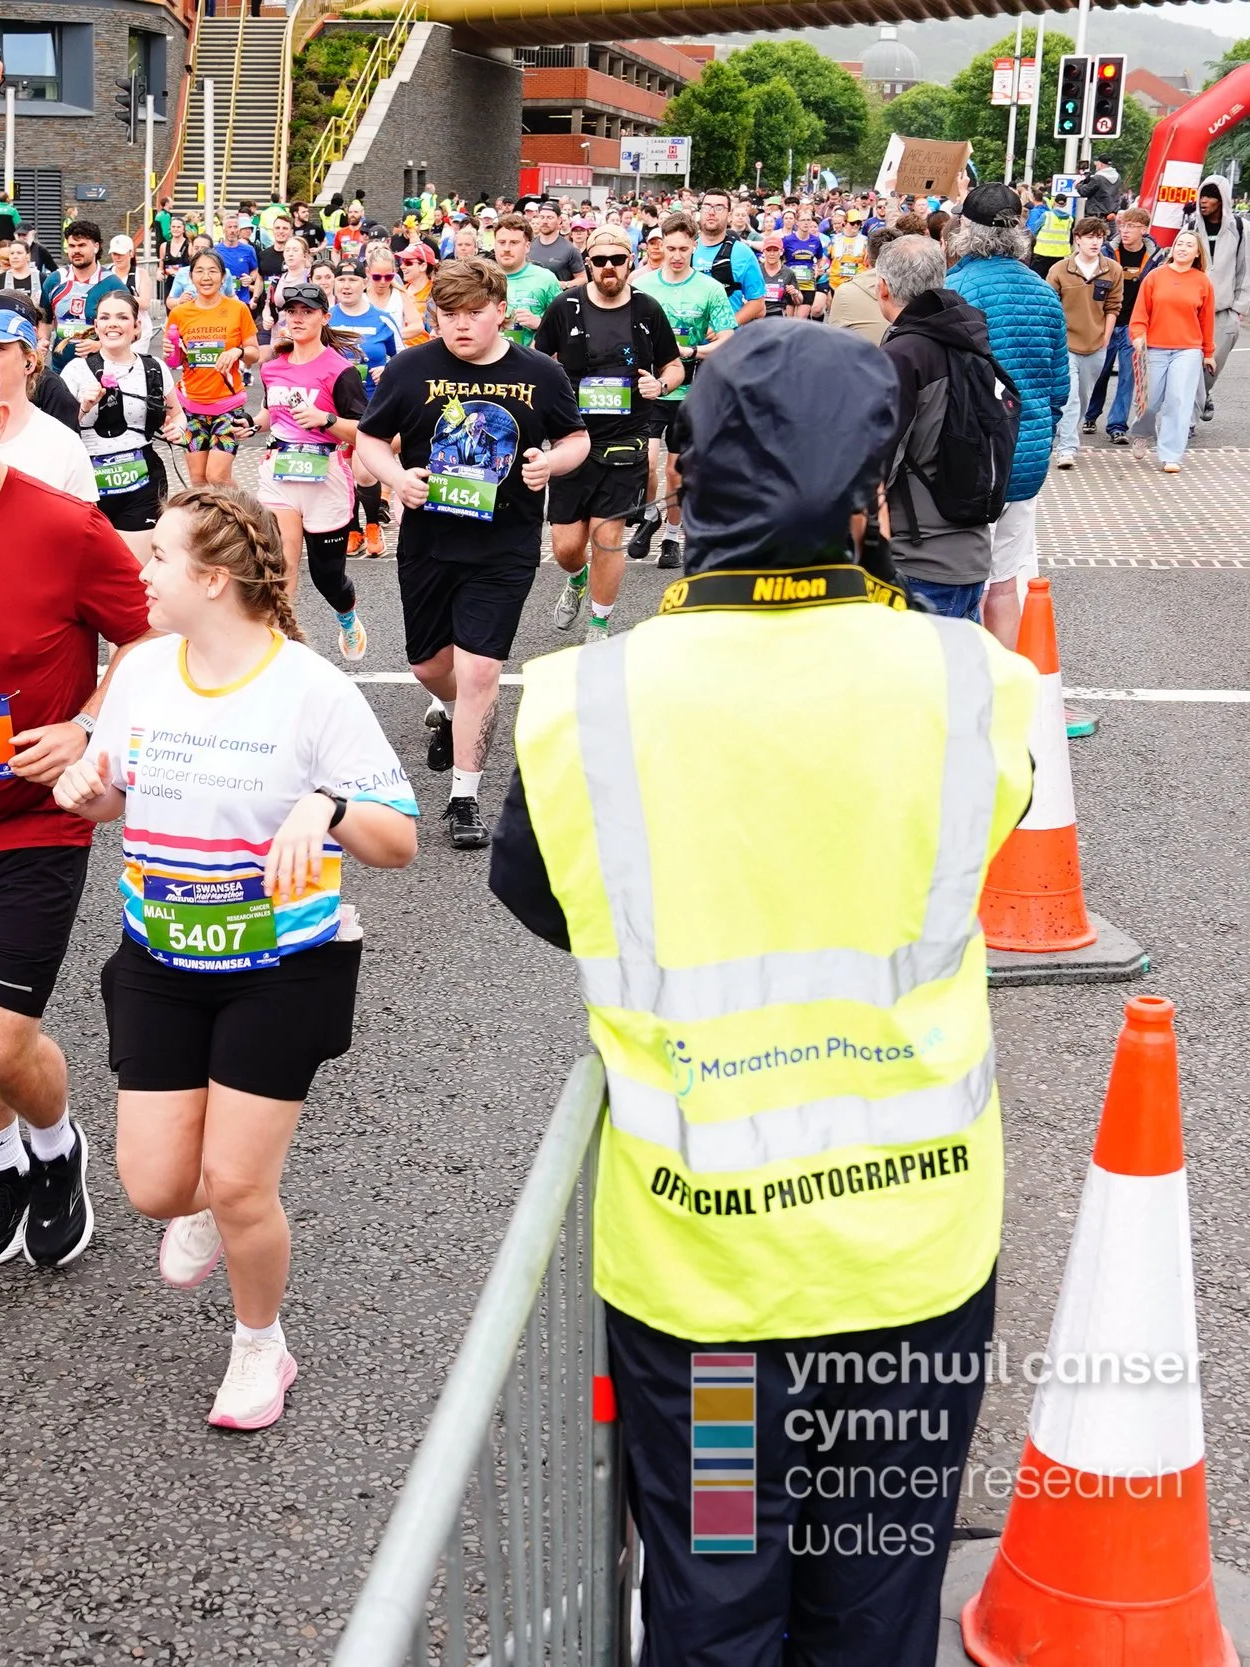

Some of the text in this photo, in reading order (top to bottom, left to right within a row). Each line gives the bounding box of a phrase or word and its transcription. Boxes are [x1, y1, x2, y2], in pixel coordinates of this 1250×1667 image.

[187, 326, 227, 335] EASTLEIGH
[195, 353, 219, 362] 5537
[424, 380, 537, 411] MEGADETH
[589, 394, 622, 407] 3336
[94, 466, 123, 475] DANIELLE
[288, 460, 313, 473] 739
[105, 470, 139, 487] 1020
[427, 475, 449, 486] RHYS
[439, 486, 480, 508] 1454
[752, 577, 828, 602] Nikon
[151, 729, 278, 754] ymchwil canser
[145, 747, 193, 764] cymru
[141, 765, 264, 792] cancer research
[139, 783, 183, 800] wales
[195, 881, 243, 893] SWANSEA
[144, 904, 176, 920] MALI
[226, 910, 271, 921] RESEARCH WALES
[249, 903, 270, 912] CANCER
[169, 921, 247, 953] 5407
[172, 956, 252, 971] #RUNSWANSEA
[700, 1045, 820, 1082] Marathon
[826, 1037, 915, 1063] Photos
[764, 1144, 969, 1213] PHOTOGRAPHER
